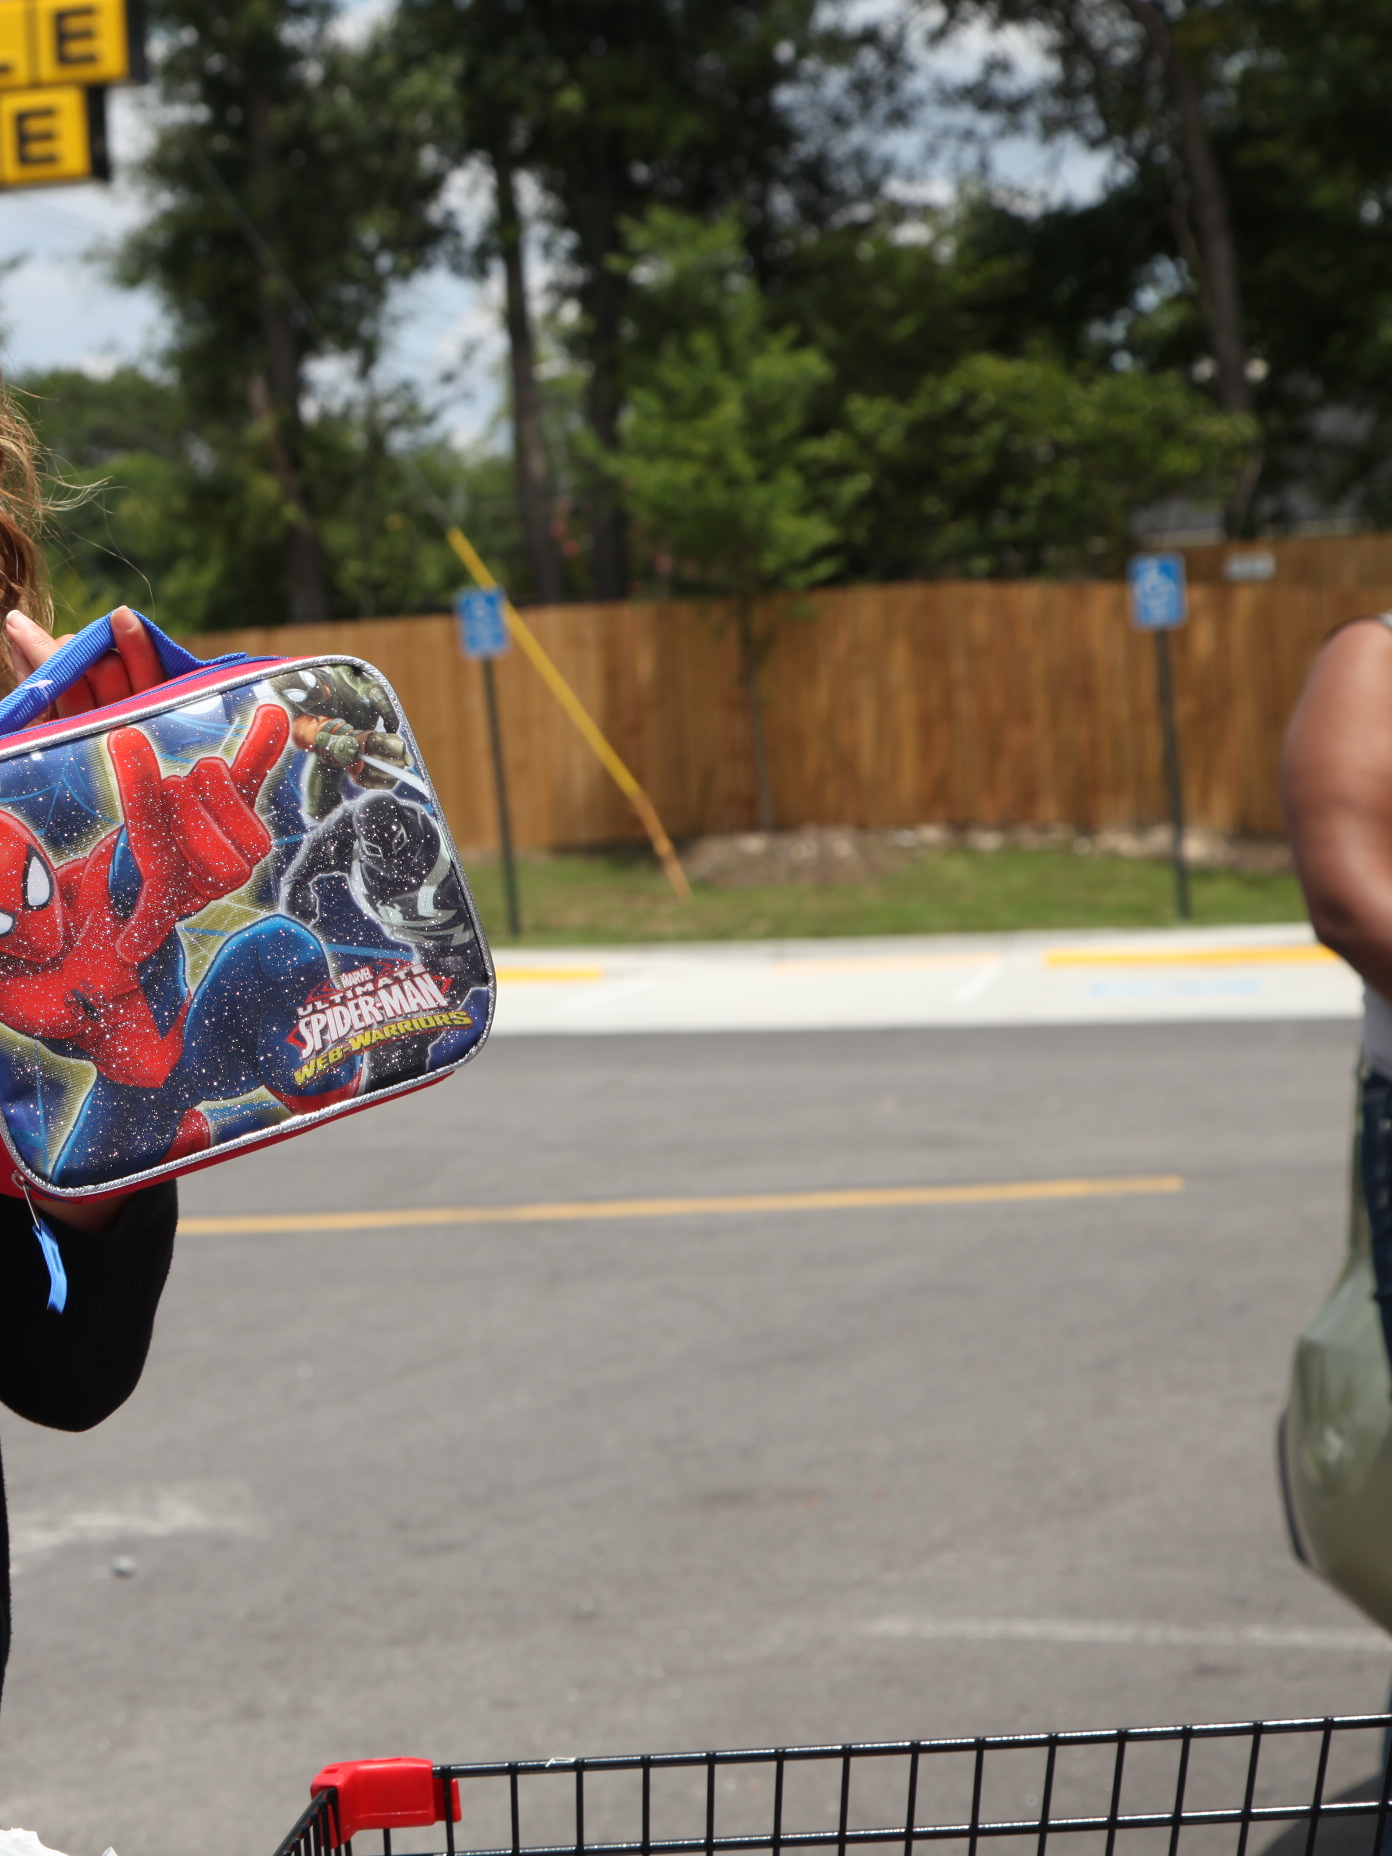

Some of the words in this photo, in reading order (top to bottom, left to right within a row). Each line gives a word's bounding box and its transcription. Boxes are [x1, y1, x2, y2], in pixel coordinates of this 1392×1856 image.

[297, 964, 426, 1015] ULTIMATE
[339, 966, 373, 989] MARVEL
[294, 1010, 473, 1085] WEB-WARRIORS
[298, 974, 450, 1060] SPIDER-MAN
